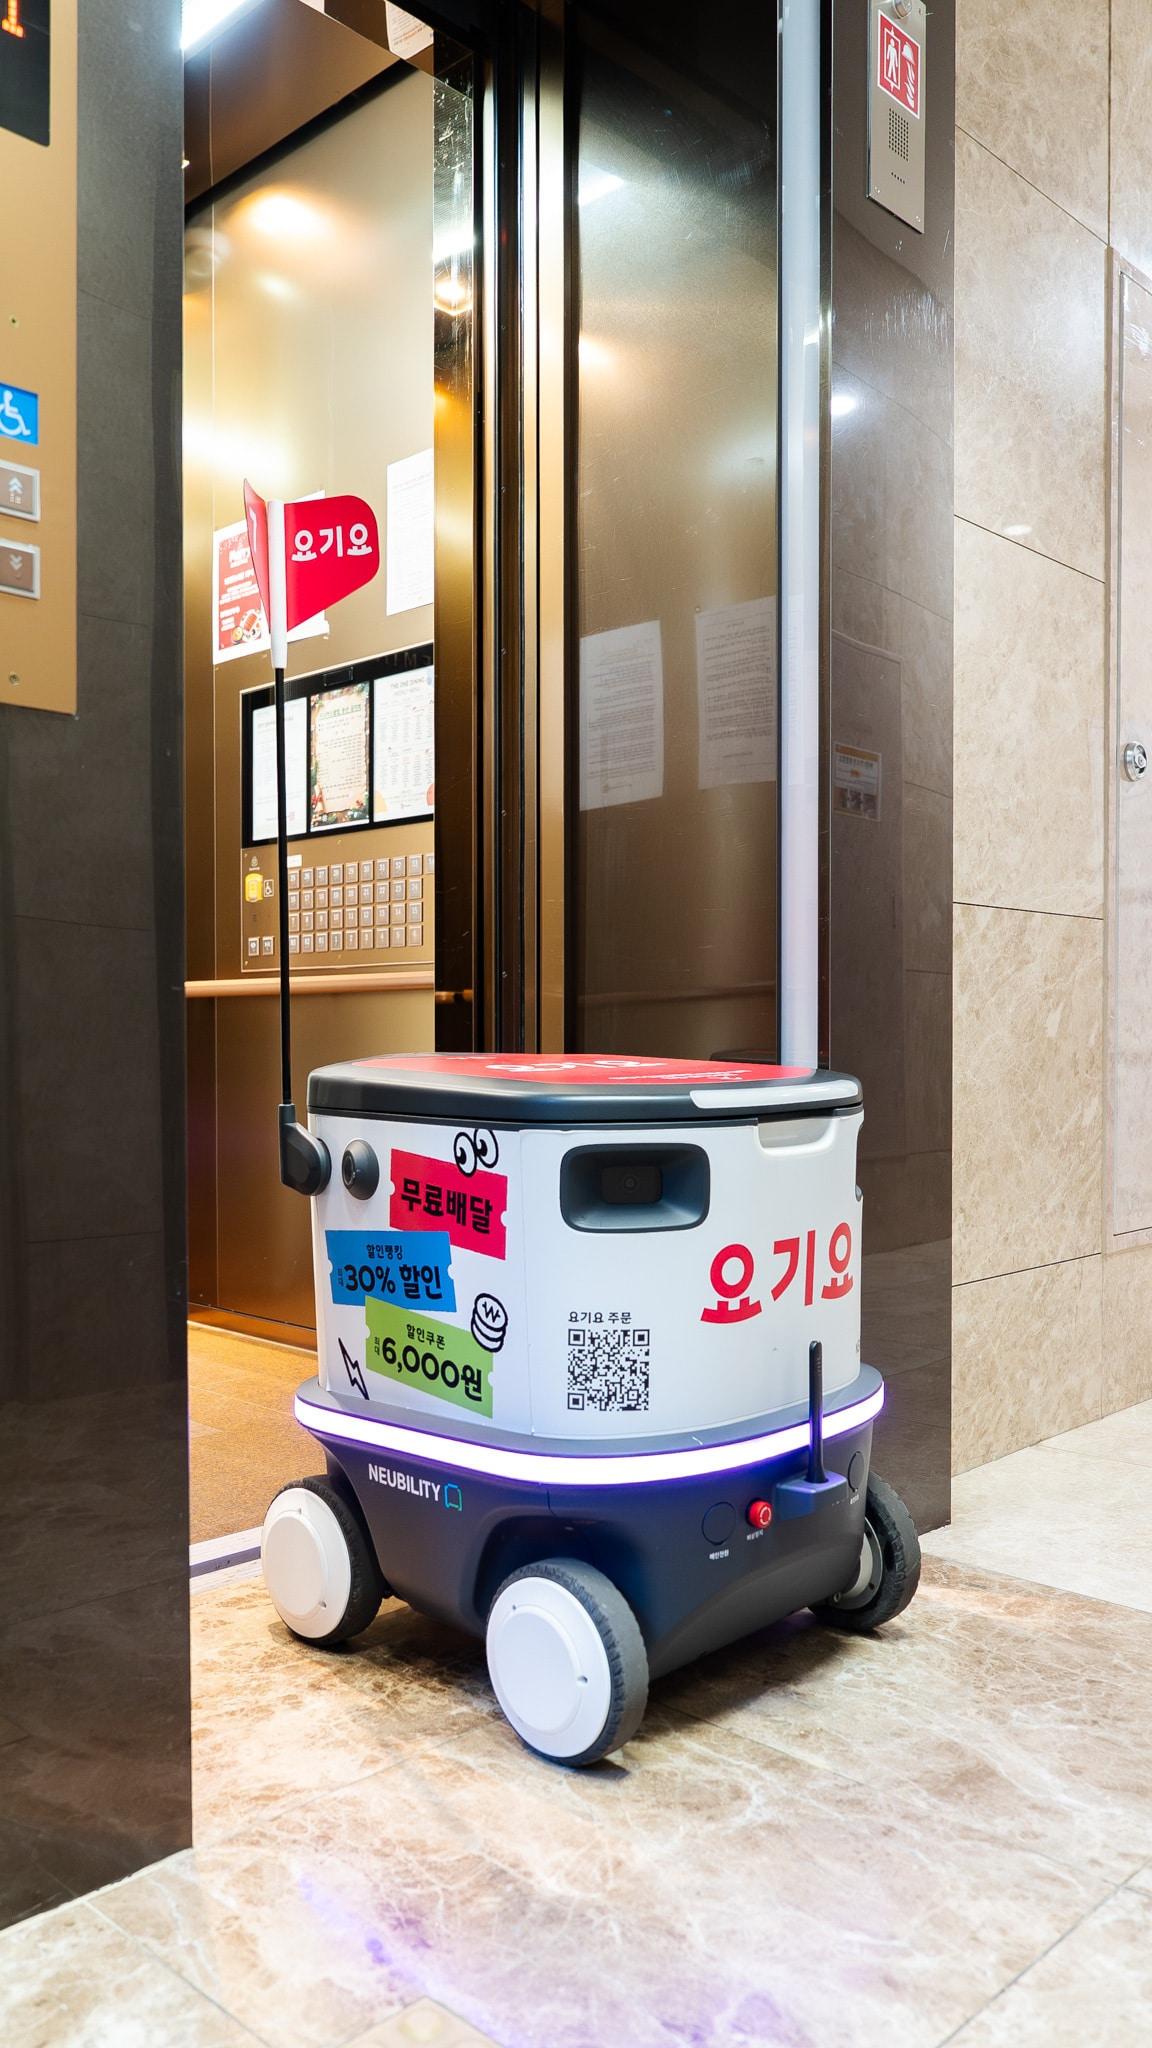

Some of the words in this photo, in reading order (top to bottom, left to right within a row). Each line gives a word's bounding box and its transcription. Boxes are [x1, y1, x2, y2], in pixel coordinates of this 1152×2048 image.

[291, 523, 373, 562] 요기요
[401, 1177, 493, 1235] 무료배달
[366, 1244, 403, 1260] 할인랭킹
[344, 1265, 396, 1294] 30%
[399, 1264, 443, 1300] 할인
[700, 1222, 853, 1324] 요기요
[568, 1311, 604, 1324] 요기요
[608, 1312, 632, 1324] 주문
[406, 1324, 445, 1350] 할인쿠폰
[382, 1337, 482, 1402] 6,000원
[368, 1463, 440, 1501] NEUBILITY
